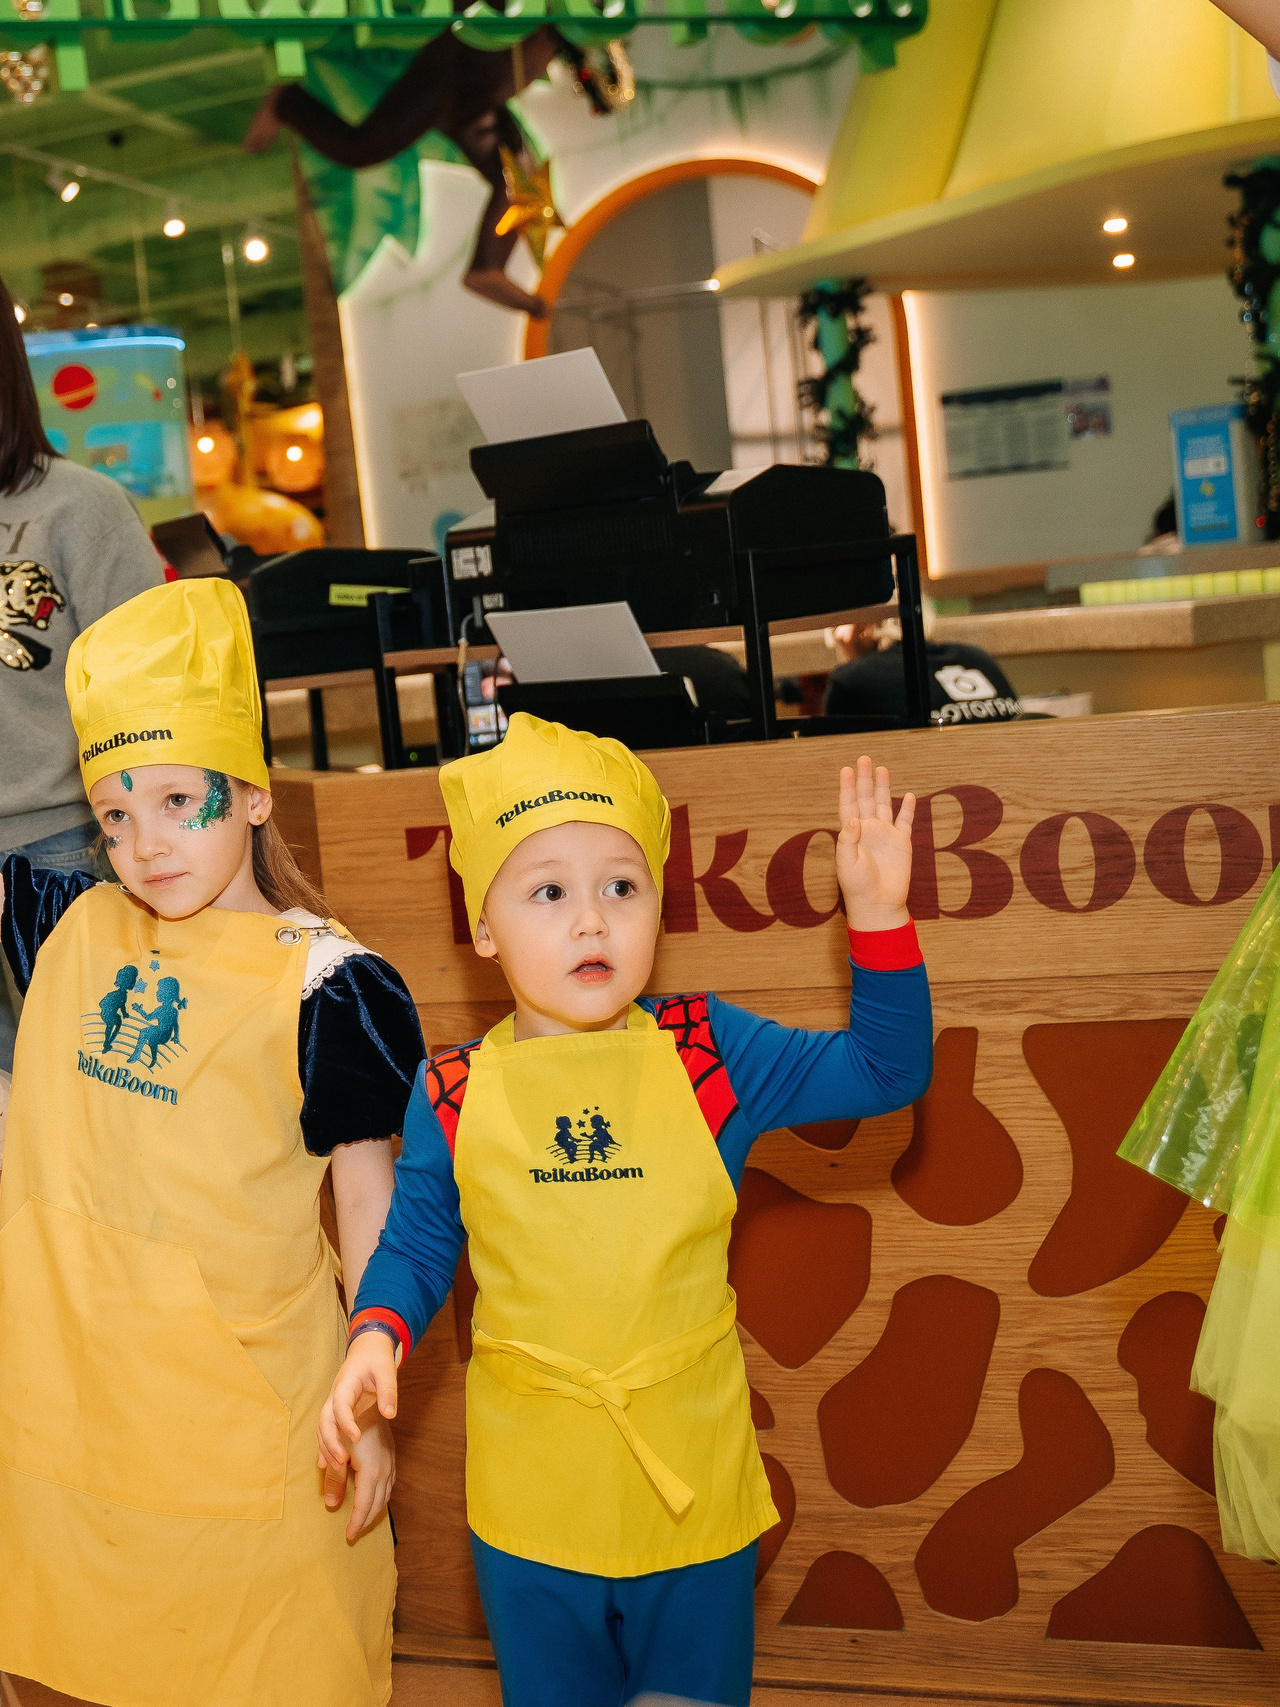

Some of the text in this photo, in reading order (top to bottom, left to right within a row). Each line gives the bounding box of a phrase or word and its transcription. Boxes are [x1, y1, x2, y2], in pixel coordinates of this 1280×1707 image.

[404, 784, 1280, 945] kaBoo
[77, 1049, 178, 1105] TeikaBoom
[529, 1166, 644, 1183] TeikaBoom
